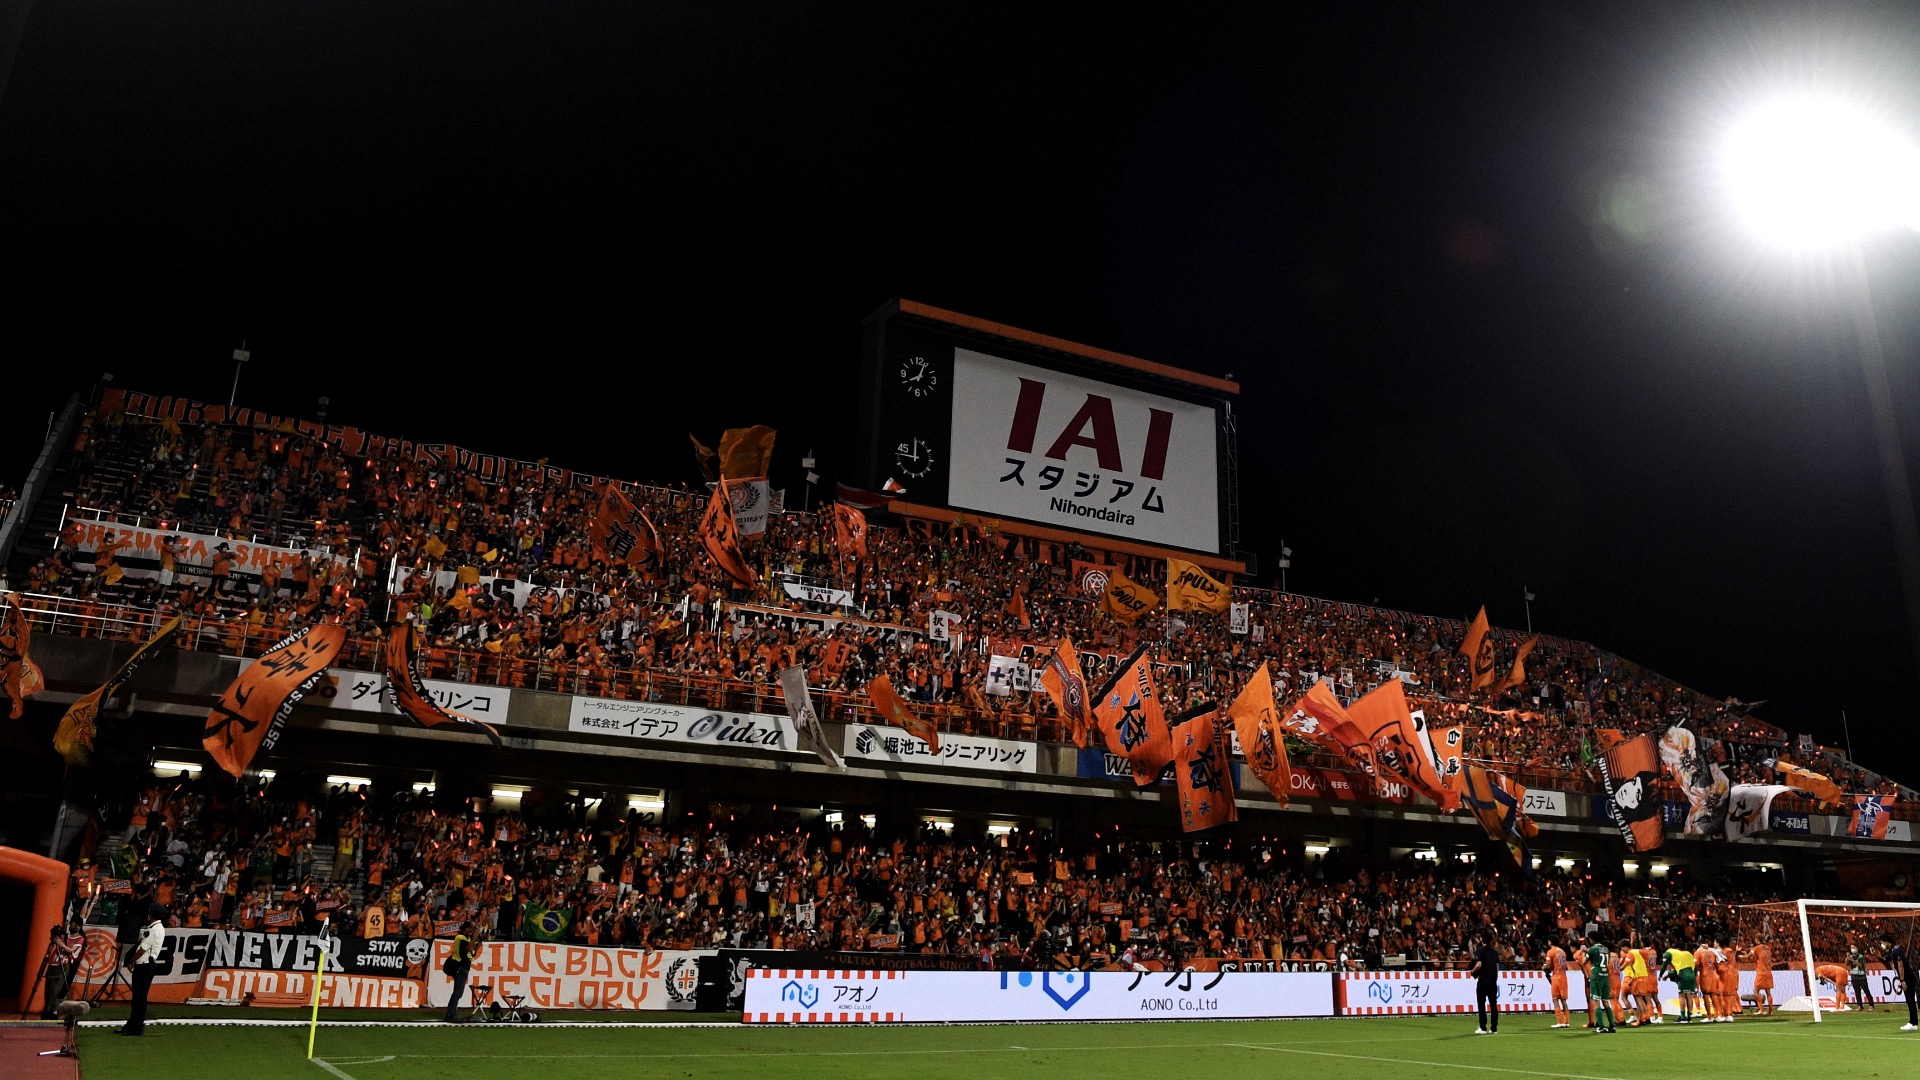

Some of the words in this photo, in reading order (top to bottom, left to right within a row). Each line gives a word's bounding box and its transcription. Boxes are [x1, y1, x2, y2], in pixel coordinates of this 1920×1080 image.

[915, 356, 924, 366] 12
[900, 369, 907, 378] 9
[930, 376, 937, 385] 3
[914, 388, 921, 397] 6
[1007, 377, 1174, 481] IAI
[897, 443, 909, 453] 45
[1000, 457, 1165, 514] スタジアム
[1050, 497, 1135, 526] Nihondaira
[808, 591, 832, 603] IAI
[262, 690, 304, 751] S-PULSE
[582, 716, 620, 730] 株式会社
[623, 717, 679, 738] イデア
[1290, 773, 1326, 791] OKAI
[370, 914, 381, 927] 45
[211, 930, 344, 973] NEVER
[368, 940, 400, 953] STAY
[356, 954, 404, 969] STRONG
[566, 947, 663, 979] BACK
[1221, 961, 1337, 972] SHIMIZ
[1599, 953, 1609, 968] 21
[530, 976, 648, 1009] GLORY
[834, 985, 879, 1002] アオノ
[1400, 984, 1430, 998] アオノ
[1507, 983, 1534, 997] アオノ
[1141, 998, 1173, 1011] AONO
[1178, 998, 1218, 1012] Co.,Ltd
